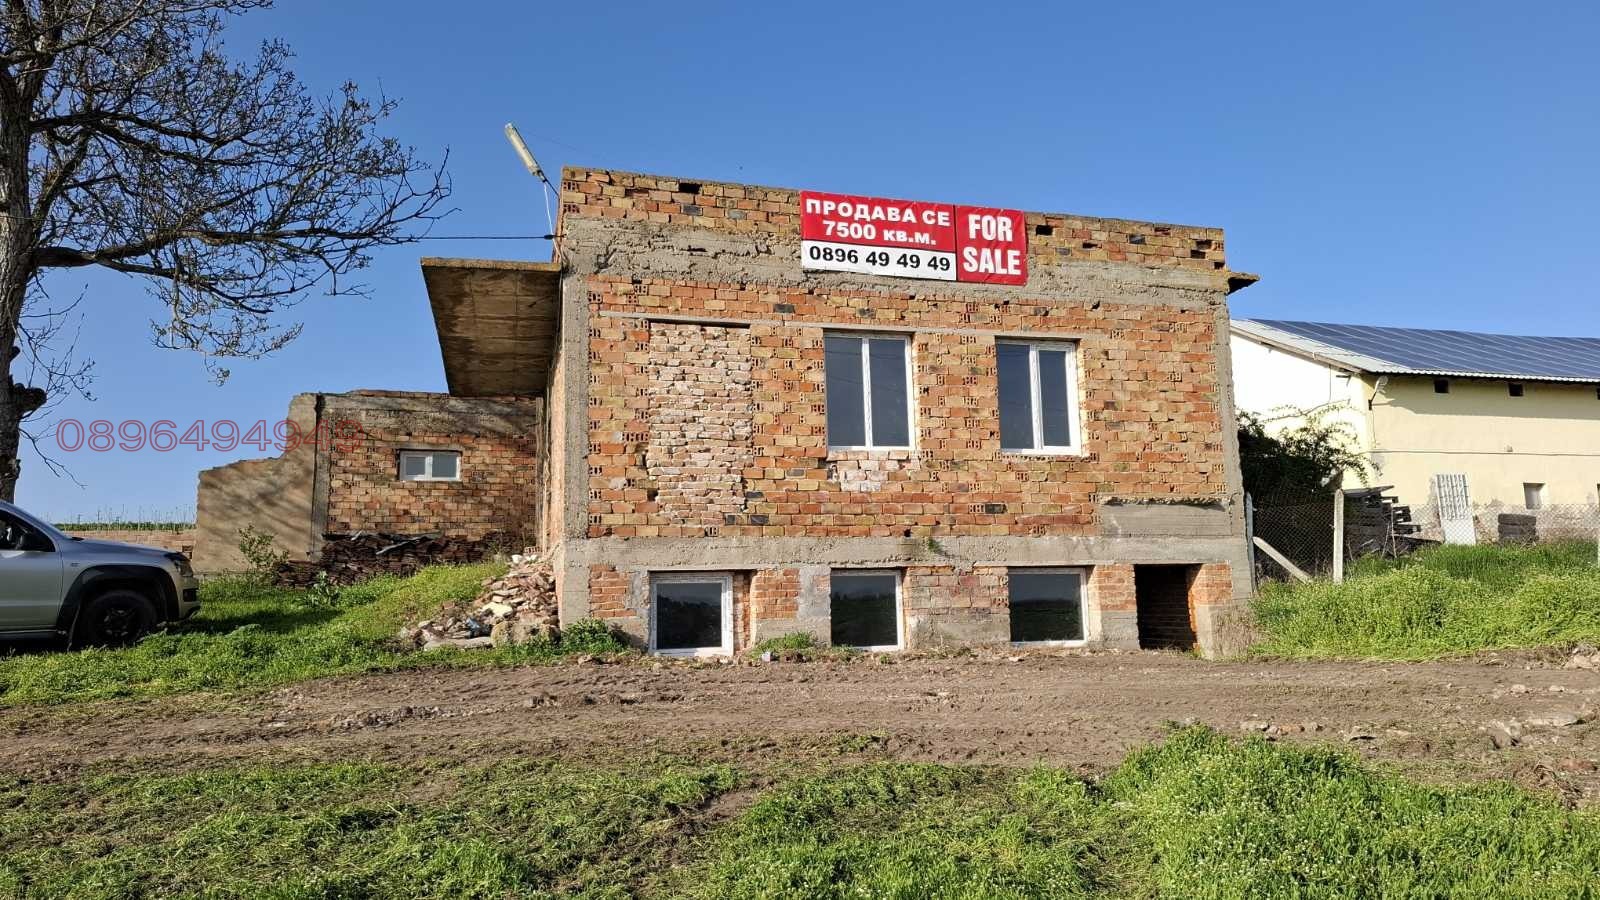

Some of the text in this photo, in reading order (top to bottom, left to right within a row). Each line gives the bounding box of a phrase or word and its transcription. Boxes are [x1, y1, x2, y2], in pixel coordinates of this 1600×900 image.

[805, 198, 952, 227] ПРОДАВА СЕ
[822, 220, 877, 240] 7500
[968, 214, 1013, 242] FOR
[809, 245, 951, 272] 0896 49 49 49
[963, 246, 1022, 275] SALE
